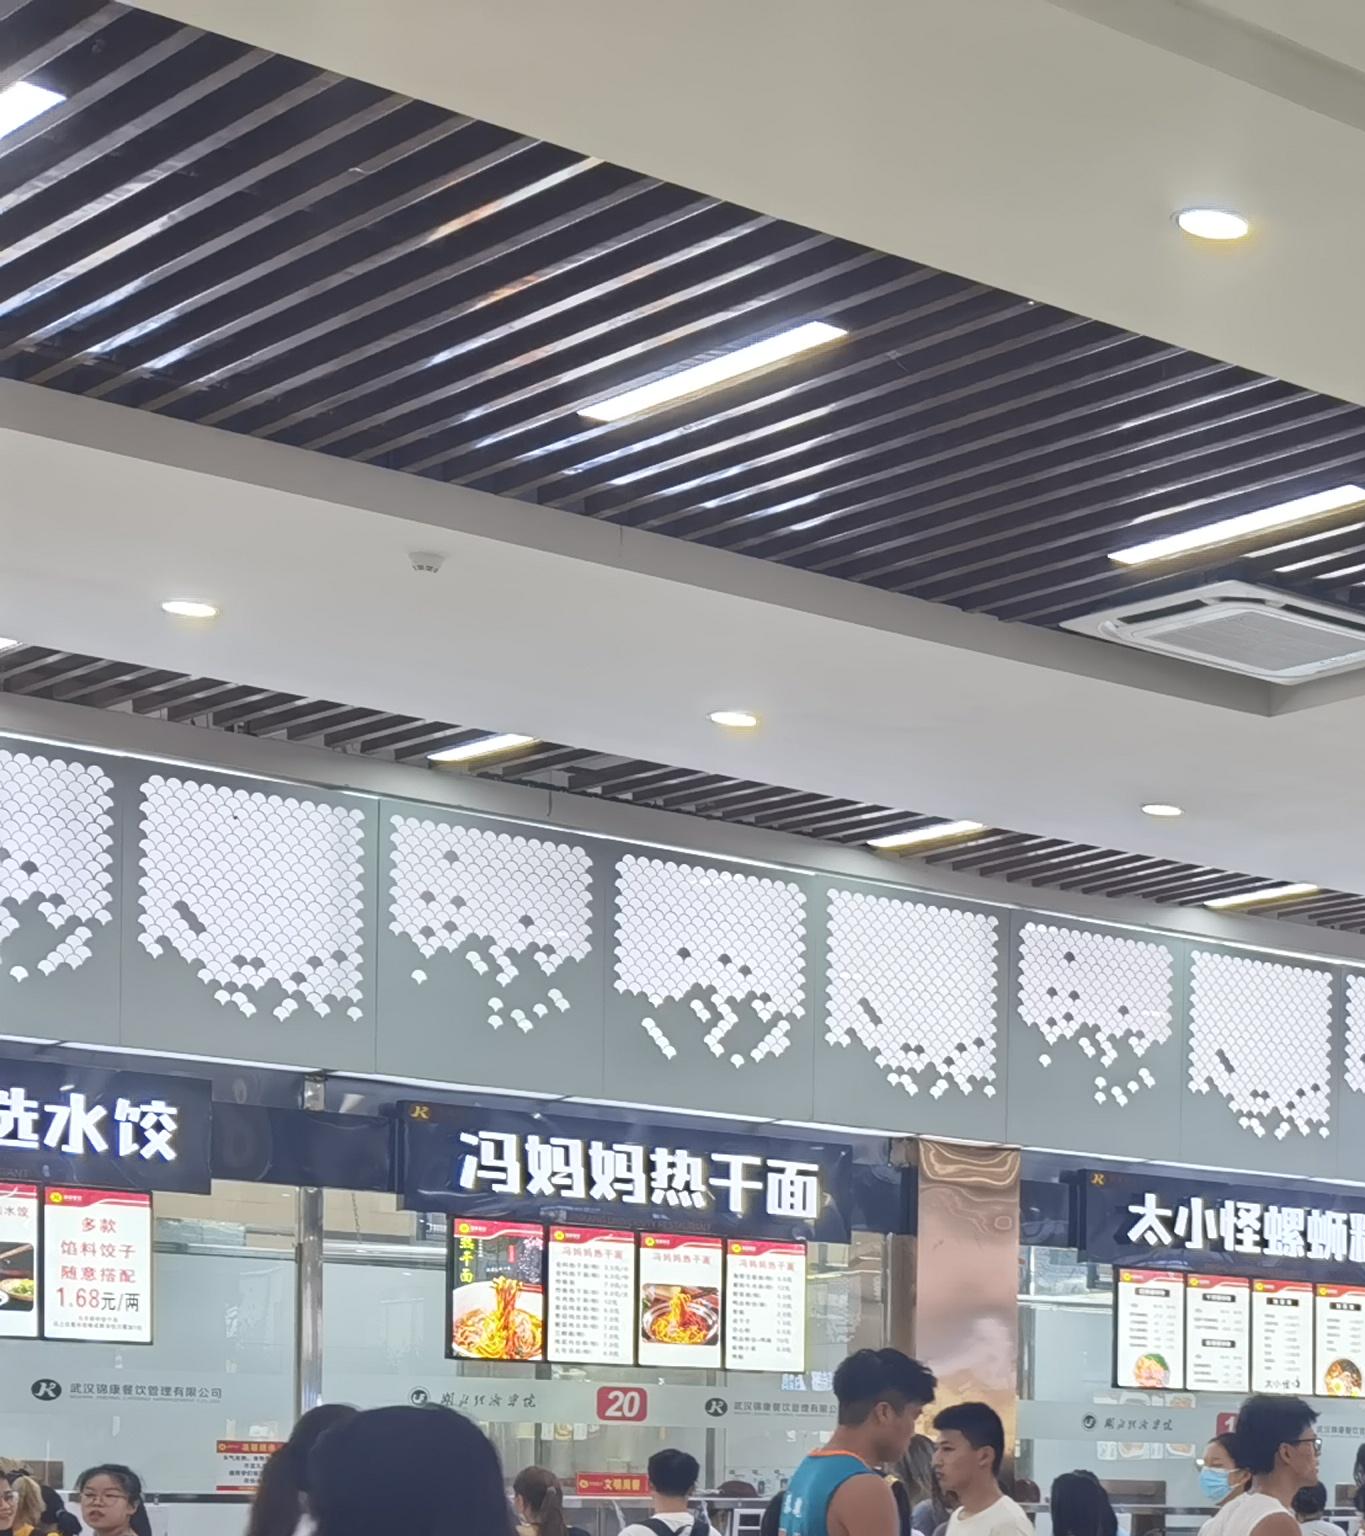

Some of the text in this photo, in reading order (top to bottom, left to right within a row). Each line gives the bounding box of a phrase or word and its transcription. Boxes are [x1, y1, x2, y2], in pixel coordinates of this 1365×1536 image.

[459, 1131, 819, 1219] 冯妈妈热干面
[81, 1217, 118, 1233] 多款
[60, 1241, 136, 1260] 馅料饺子
[60, 1265, 136, 1284] 随意搭配
[56, 1287, 141, 1313] 1.68元/两
[70, 1383, 222, 1399] 武汉锦康餐饮管理有限公司
[604, 1391, 642, 1418] 20
